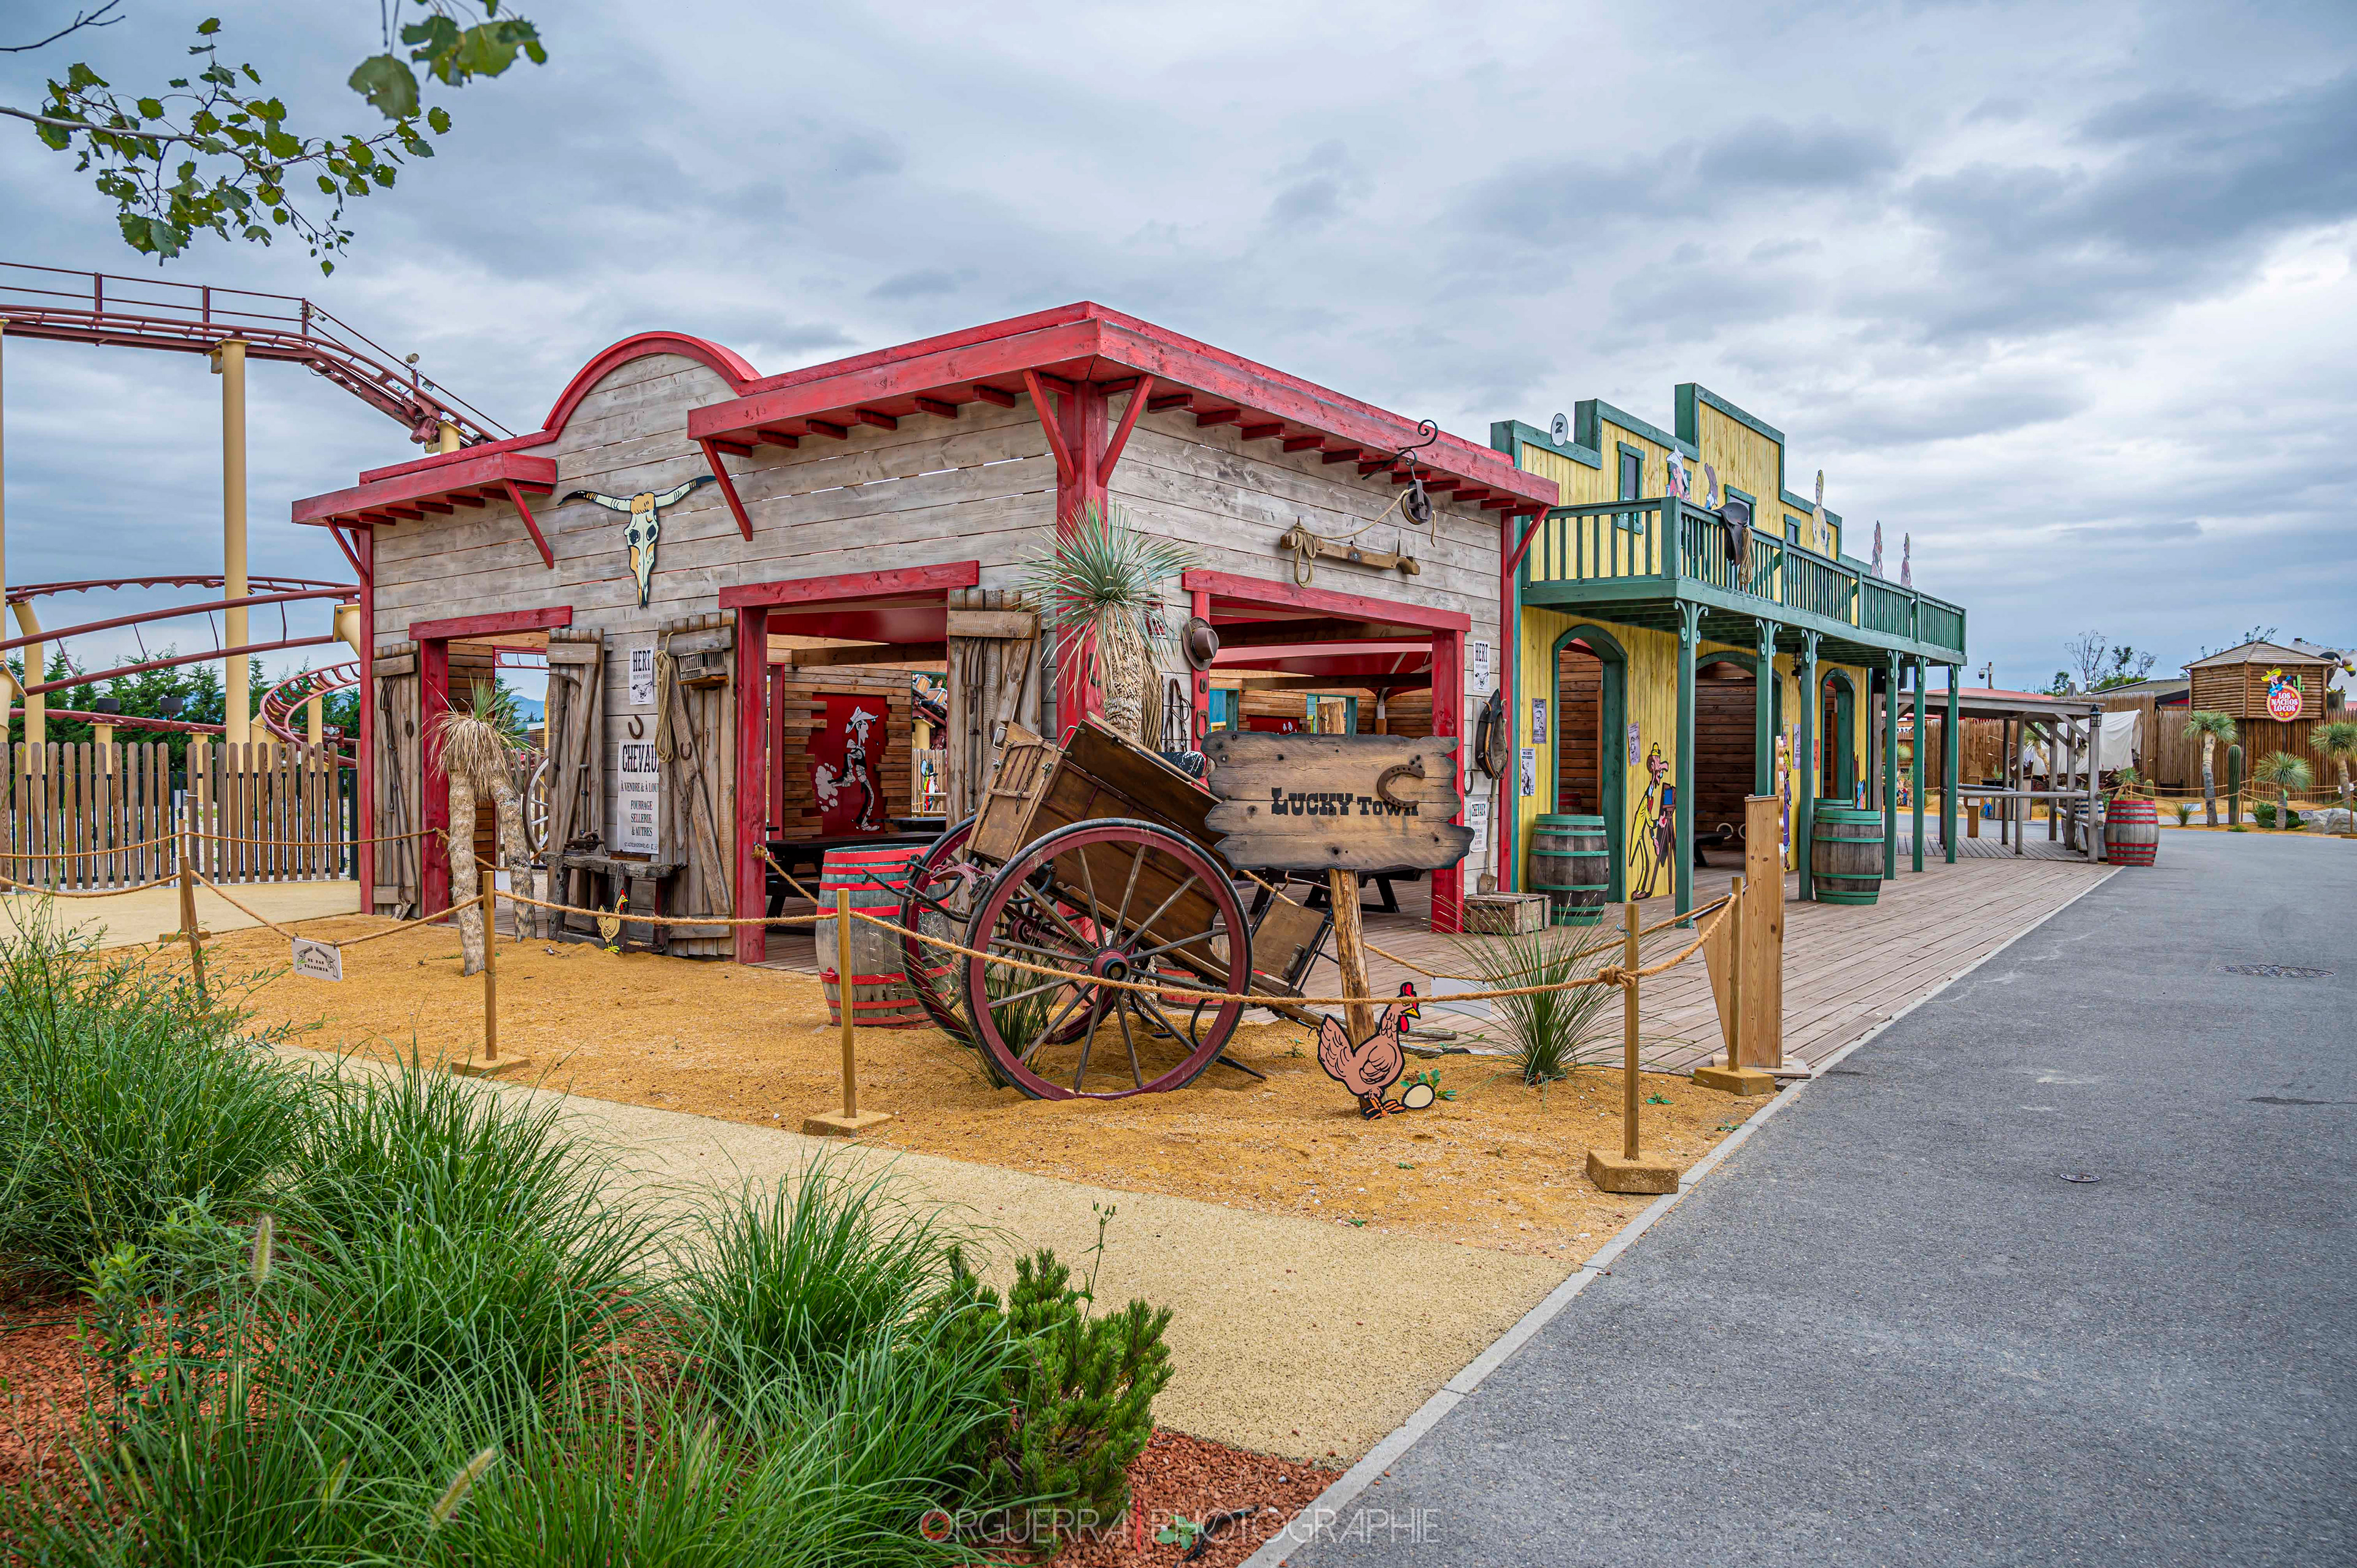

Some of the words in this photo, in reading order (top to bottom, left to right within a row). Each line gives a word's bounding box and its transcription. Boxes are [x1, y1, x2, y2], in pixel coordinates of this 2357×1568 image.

[1475, 643, 1488, 663] HERT
[633, 650, 651, 672] HERT
[622, 744, 659, 773] CHEVAU
[624, 782, 640, 792] VENDRE
[641, 783, 644, 792] &
[630, 800, 652, 810] FOURRAGE
[631, 813, 652, 823] SELLERIE
[632, 827, 635, 835] &
[636, 827, 652, 836] AUTRES
[304, 964, 329, 972] FRANCHIR
